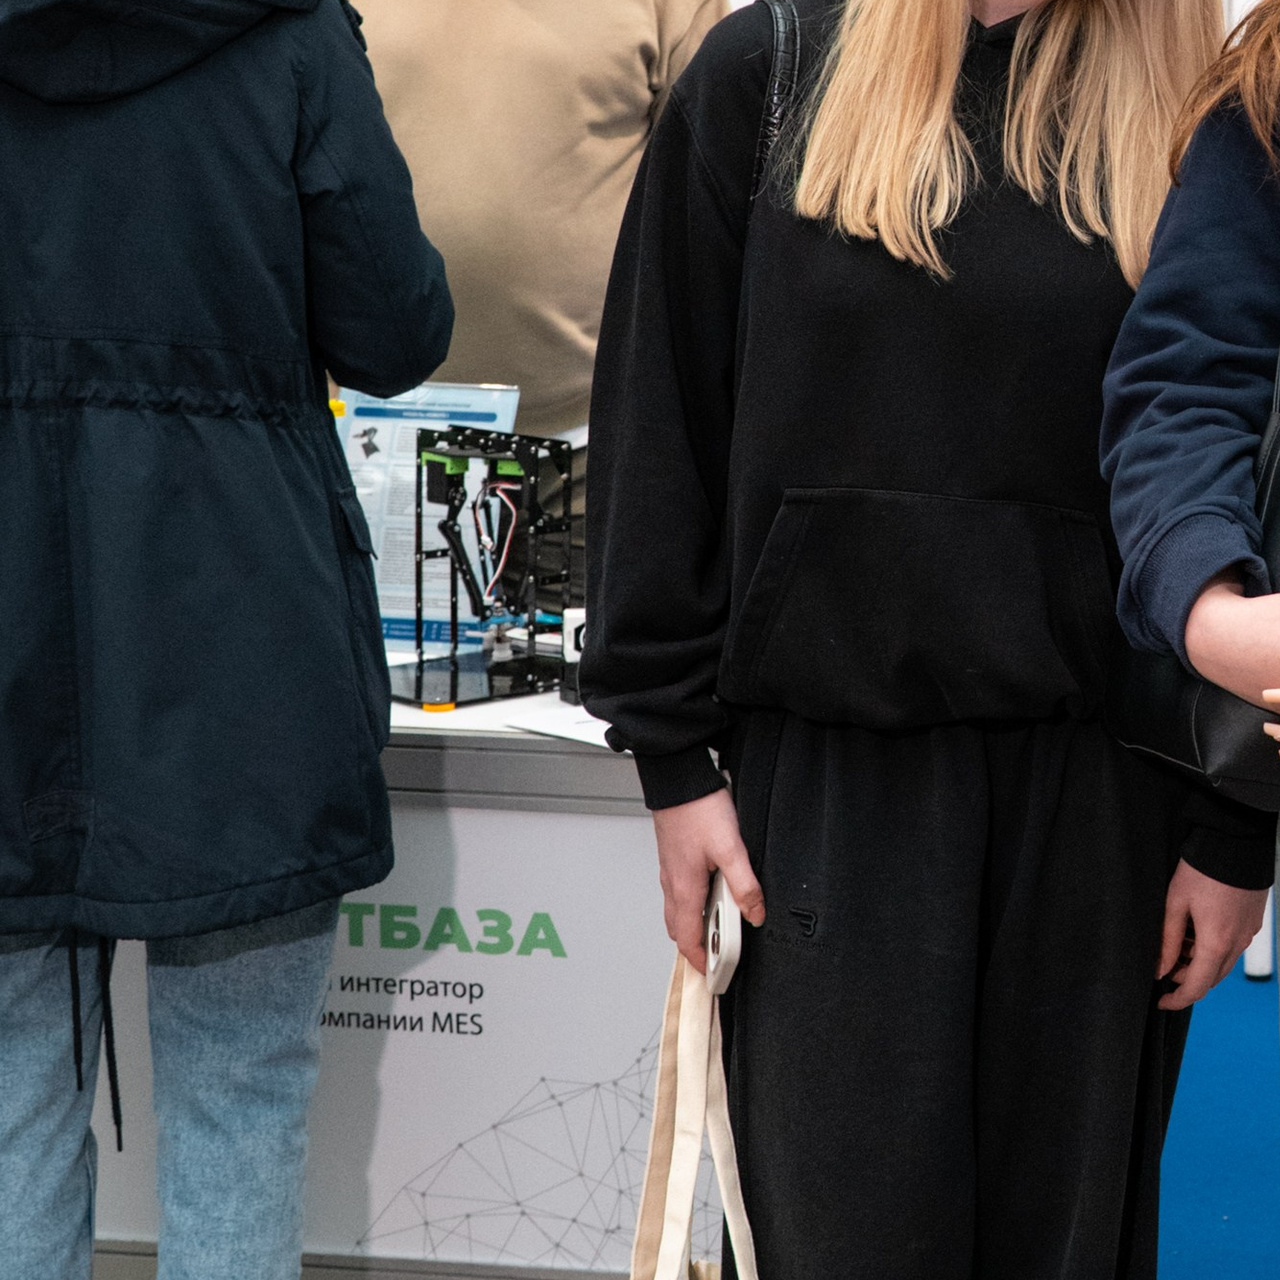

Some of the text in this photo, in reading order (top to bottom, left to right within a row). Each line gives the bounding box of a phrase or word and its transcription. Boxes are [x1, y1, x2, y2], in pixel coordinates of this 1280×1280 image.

[340, 902, 567, 958] ТБАЗА
[339, 975, 484, 1004] интегратор
[432, 1012, 483, 1035] MES
